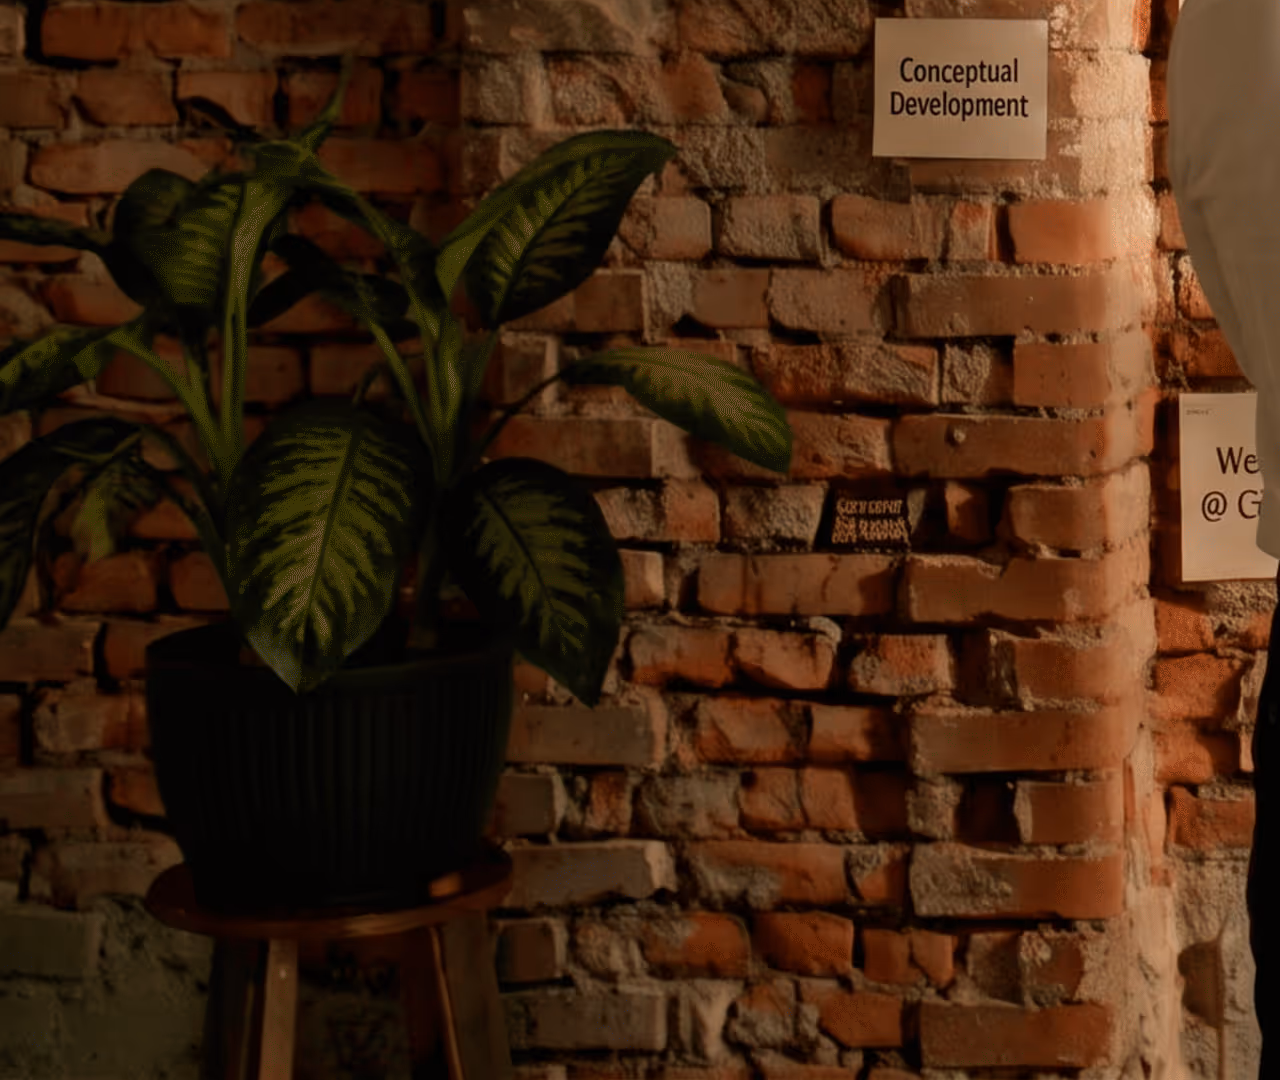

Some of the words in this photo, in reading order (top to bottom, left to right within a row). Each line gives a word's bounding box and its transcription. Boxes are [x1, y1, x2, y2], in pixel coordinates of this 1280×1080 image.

[899, 56, 1019, 89] Conceptual
[889, 90, 1029, 122] Development
[1216, 446, 1260, 475] We
[1201, 490, 1228, 523] @
